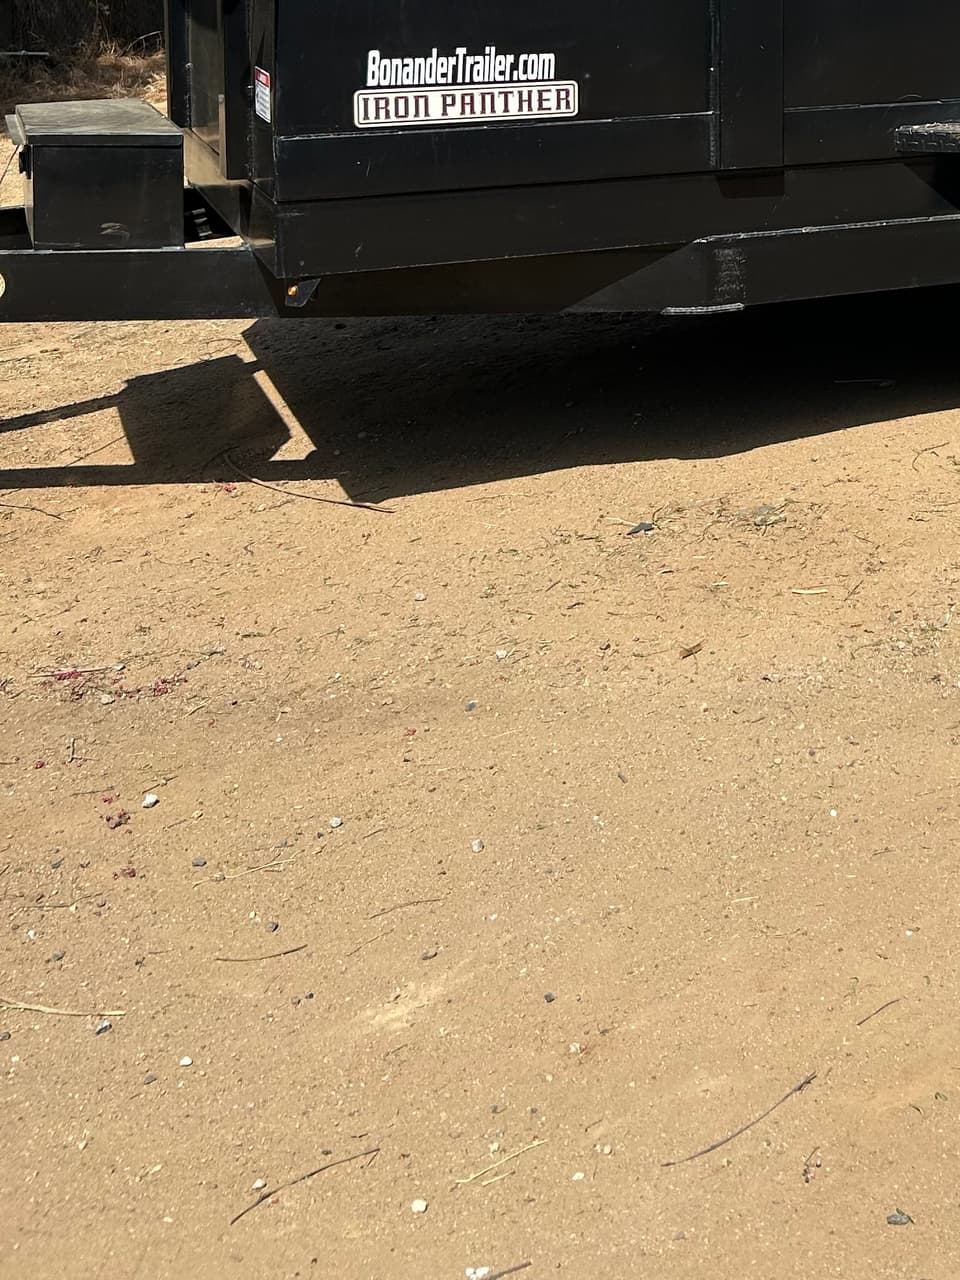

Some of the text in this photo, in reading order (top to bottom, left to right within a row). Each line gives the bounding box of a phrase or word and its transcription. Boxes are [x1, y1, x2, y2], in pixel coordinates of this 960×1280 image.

[366, 46, 556, 87] BonanderTrailer.com
[362, 88, 572, 121] IRON PANTHER
